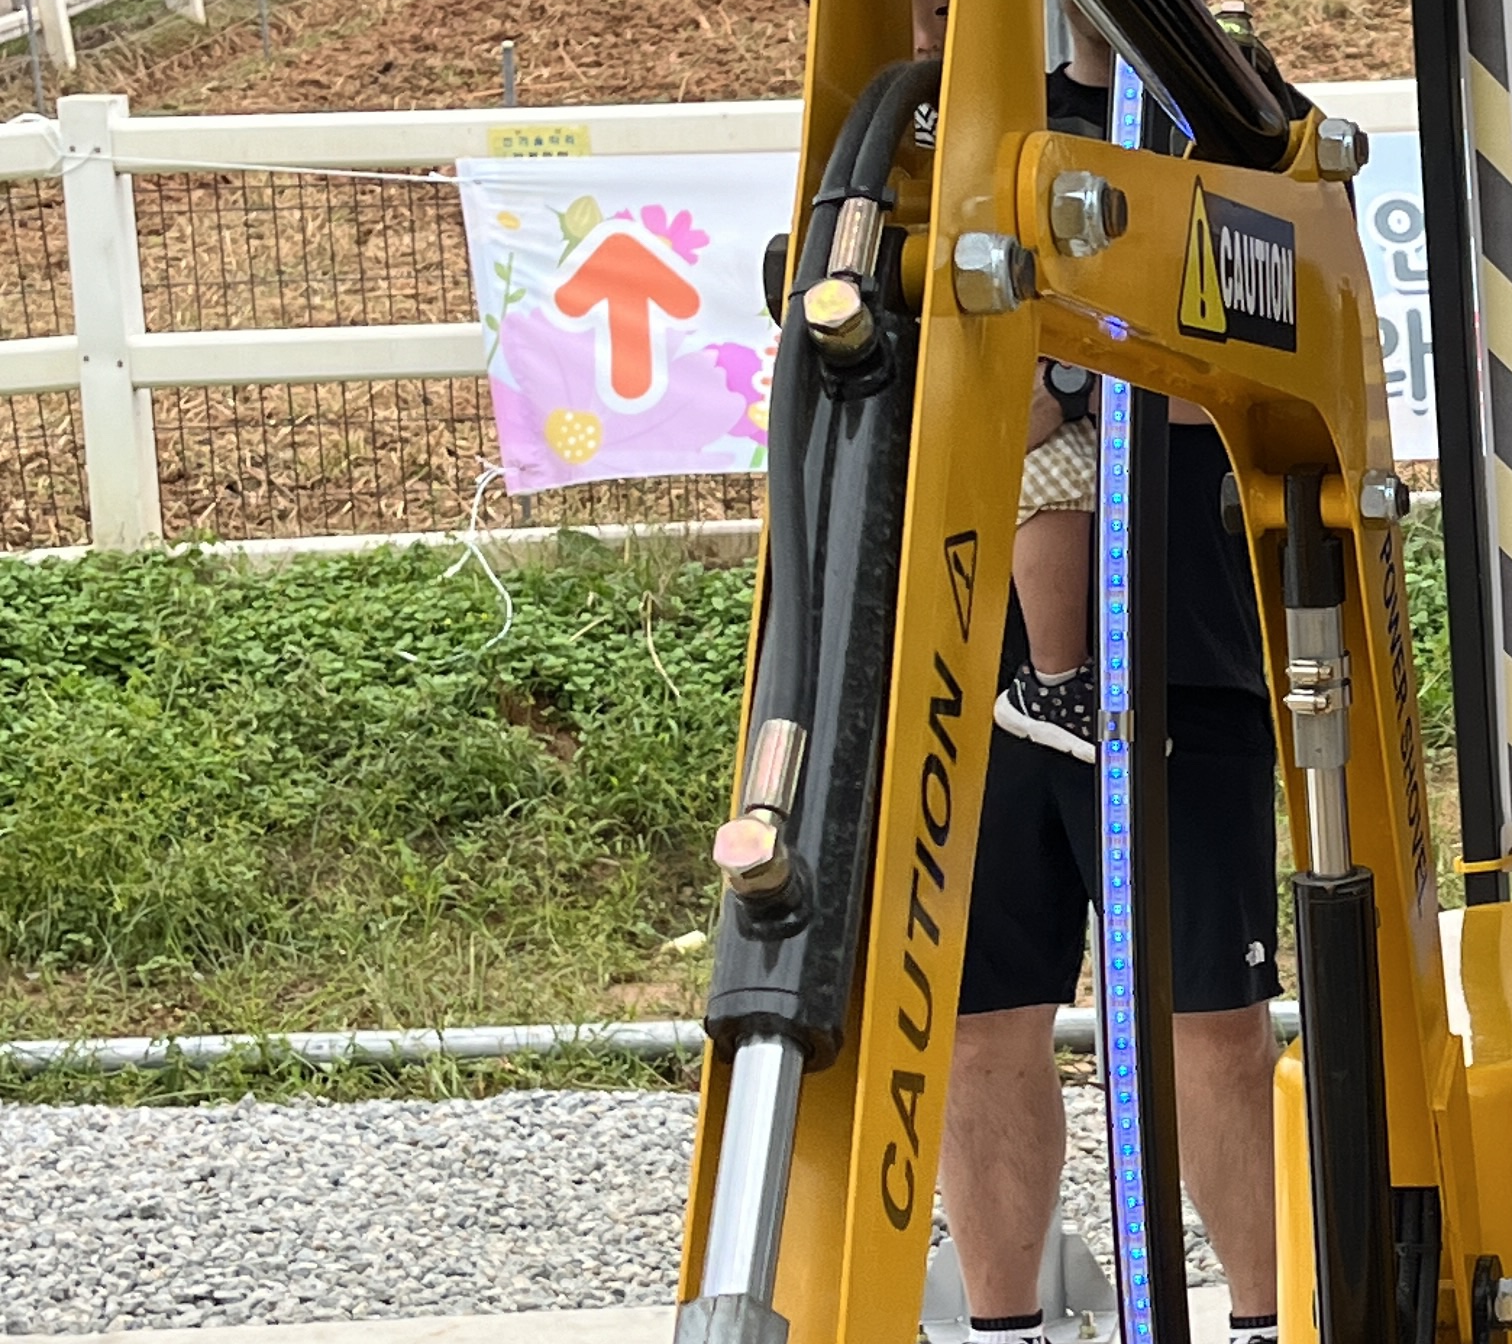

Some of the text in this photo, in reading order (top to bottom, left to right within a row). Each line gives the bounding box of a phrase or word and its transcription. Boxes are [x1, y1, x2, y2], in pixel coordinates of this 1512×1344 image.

[1220, 225, 1294, 325] CAUTION
[1379, 530, 1428, 920] POWER SHOVEL
[880, 650, 965, 1232] CAUTION
